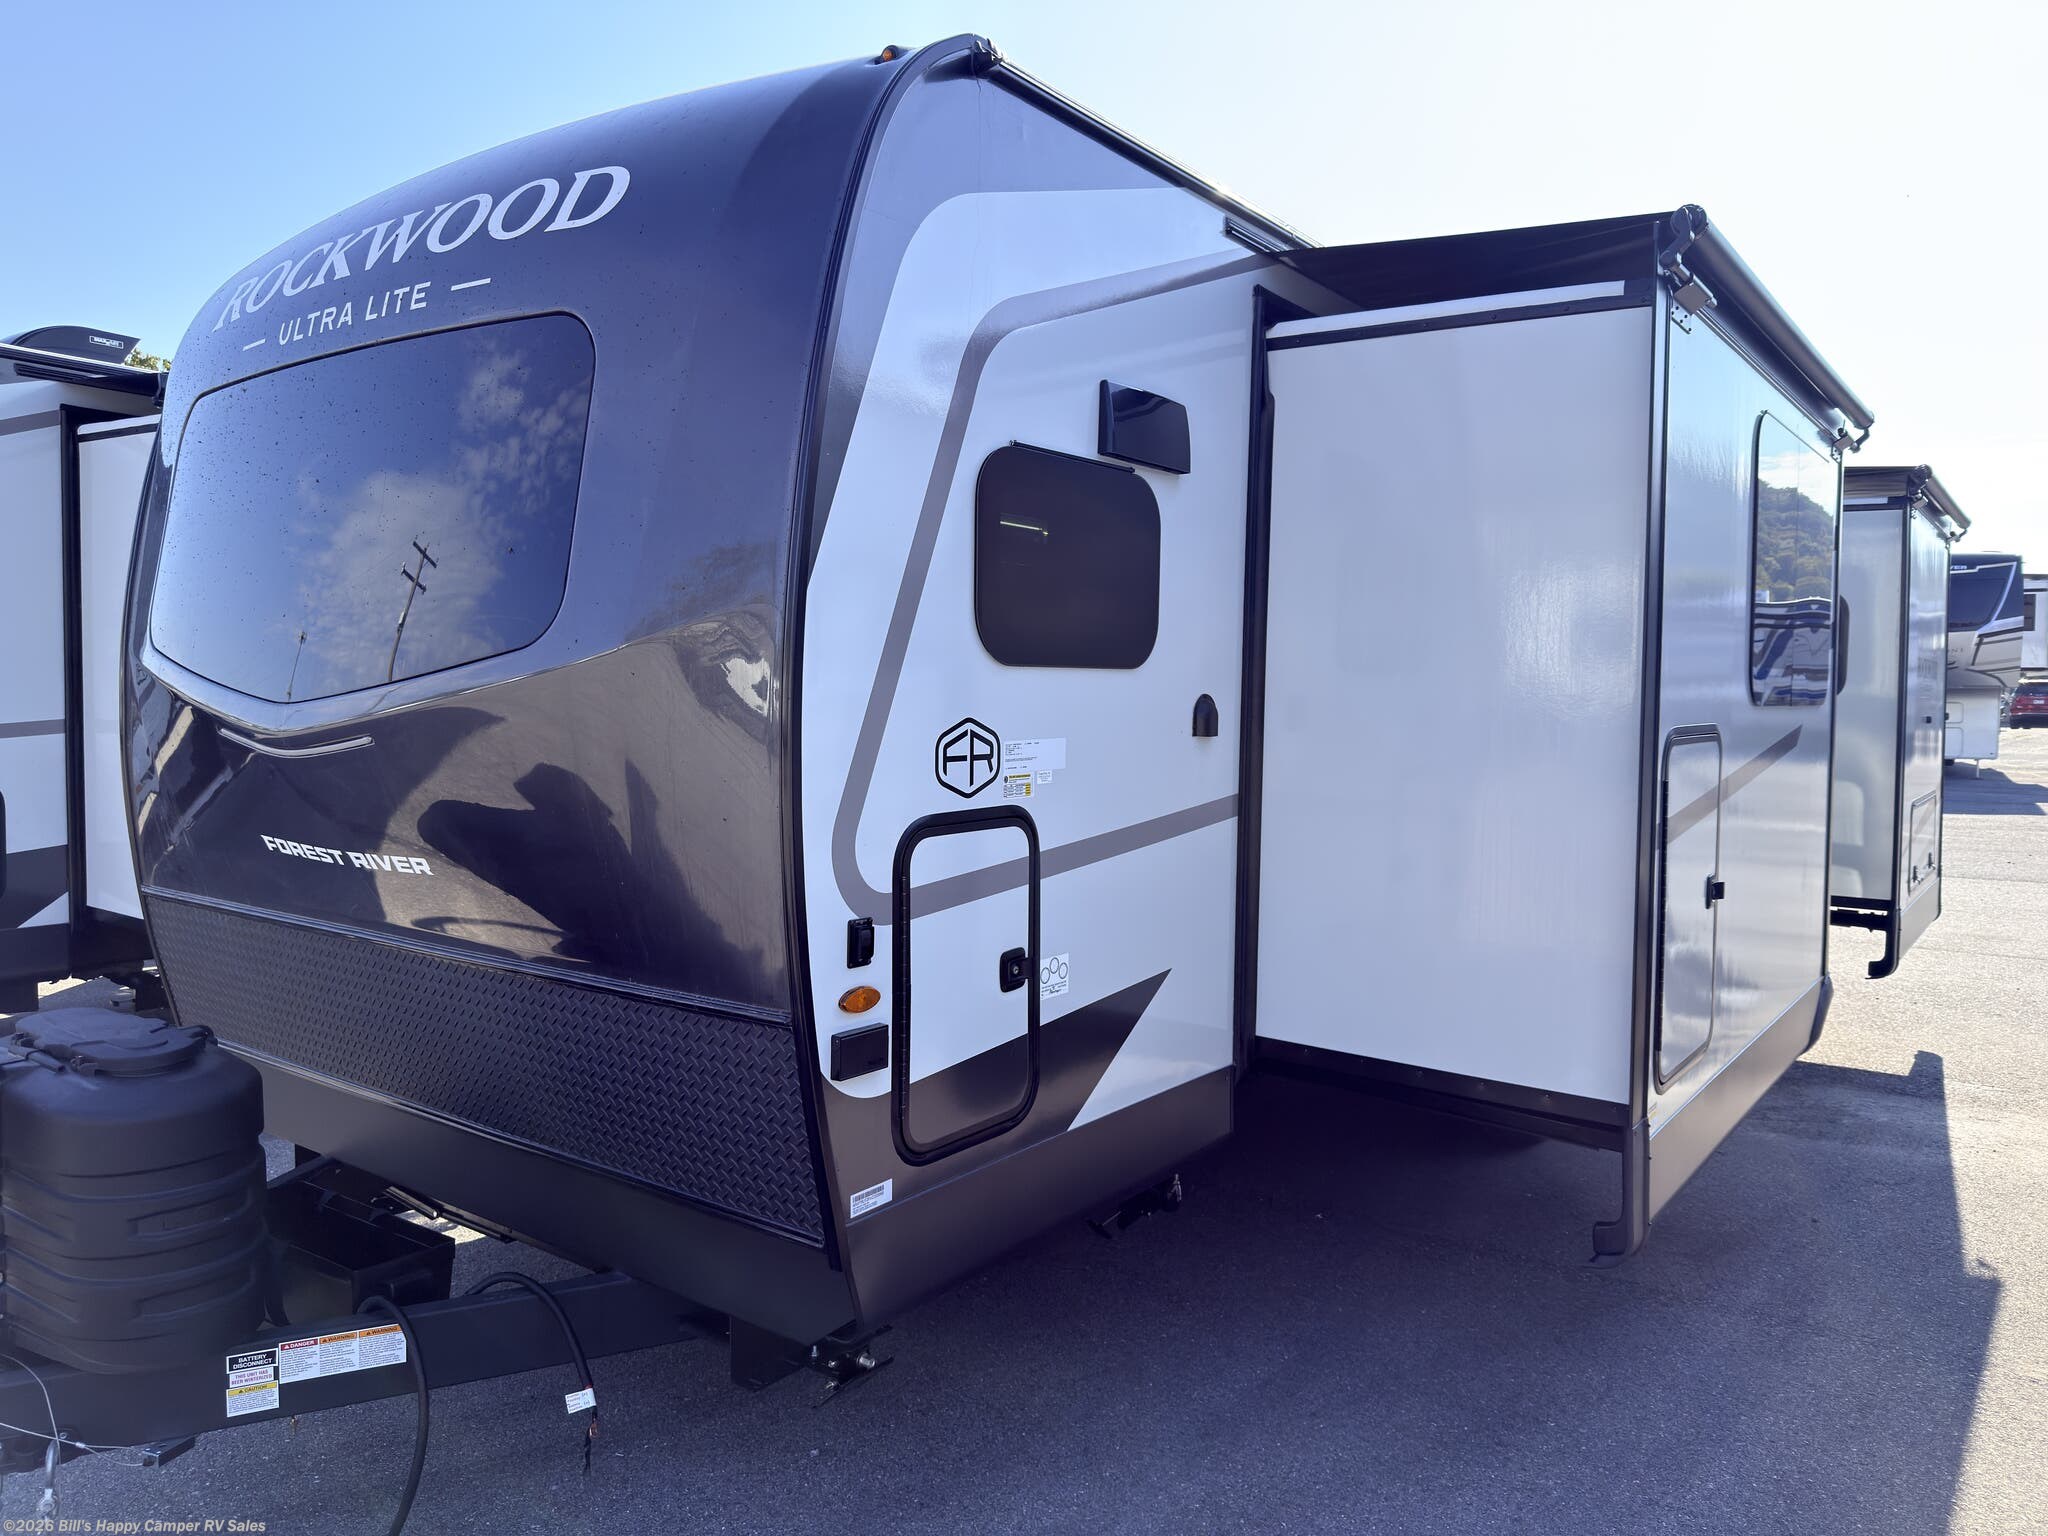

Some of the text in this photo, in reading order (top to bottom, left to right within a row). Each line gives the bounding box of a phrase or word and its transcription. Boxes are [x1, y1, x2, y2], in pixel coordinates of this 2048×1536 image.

[212, 166, 631, 332] ROCKWOOD
[279, 281, 432, 346] ULTRA LITE
[260, 835, 435, 876] FOREST RIVER
[290, 1340, 315, 1349] DANGER
[232, 1358, 273, 1370] DISCONNECT
[238, 1354, 267, 1363] BATTERY
